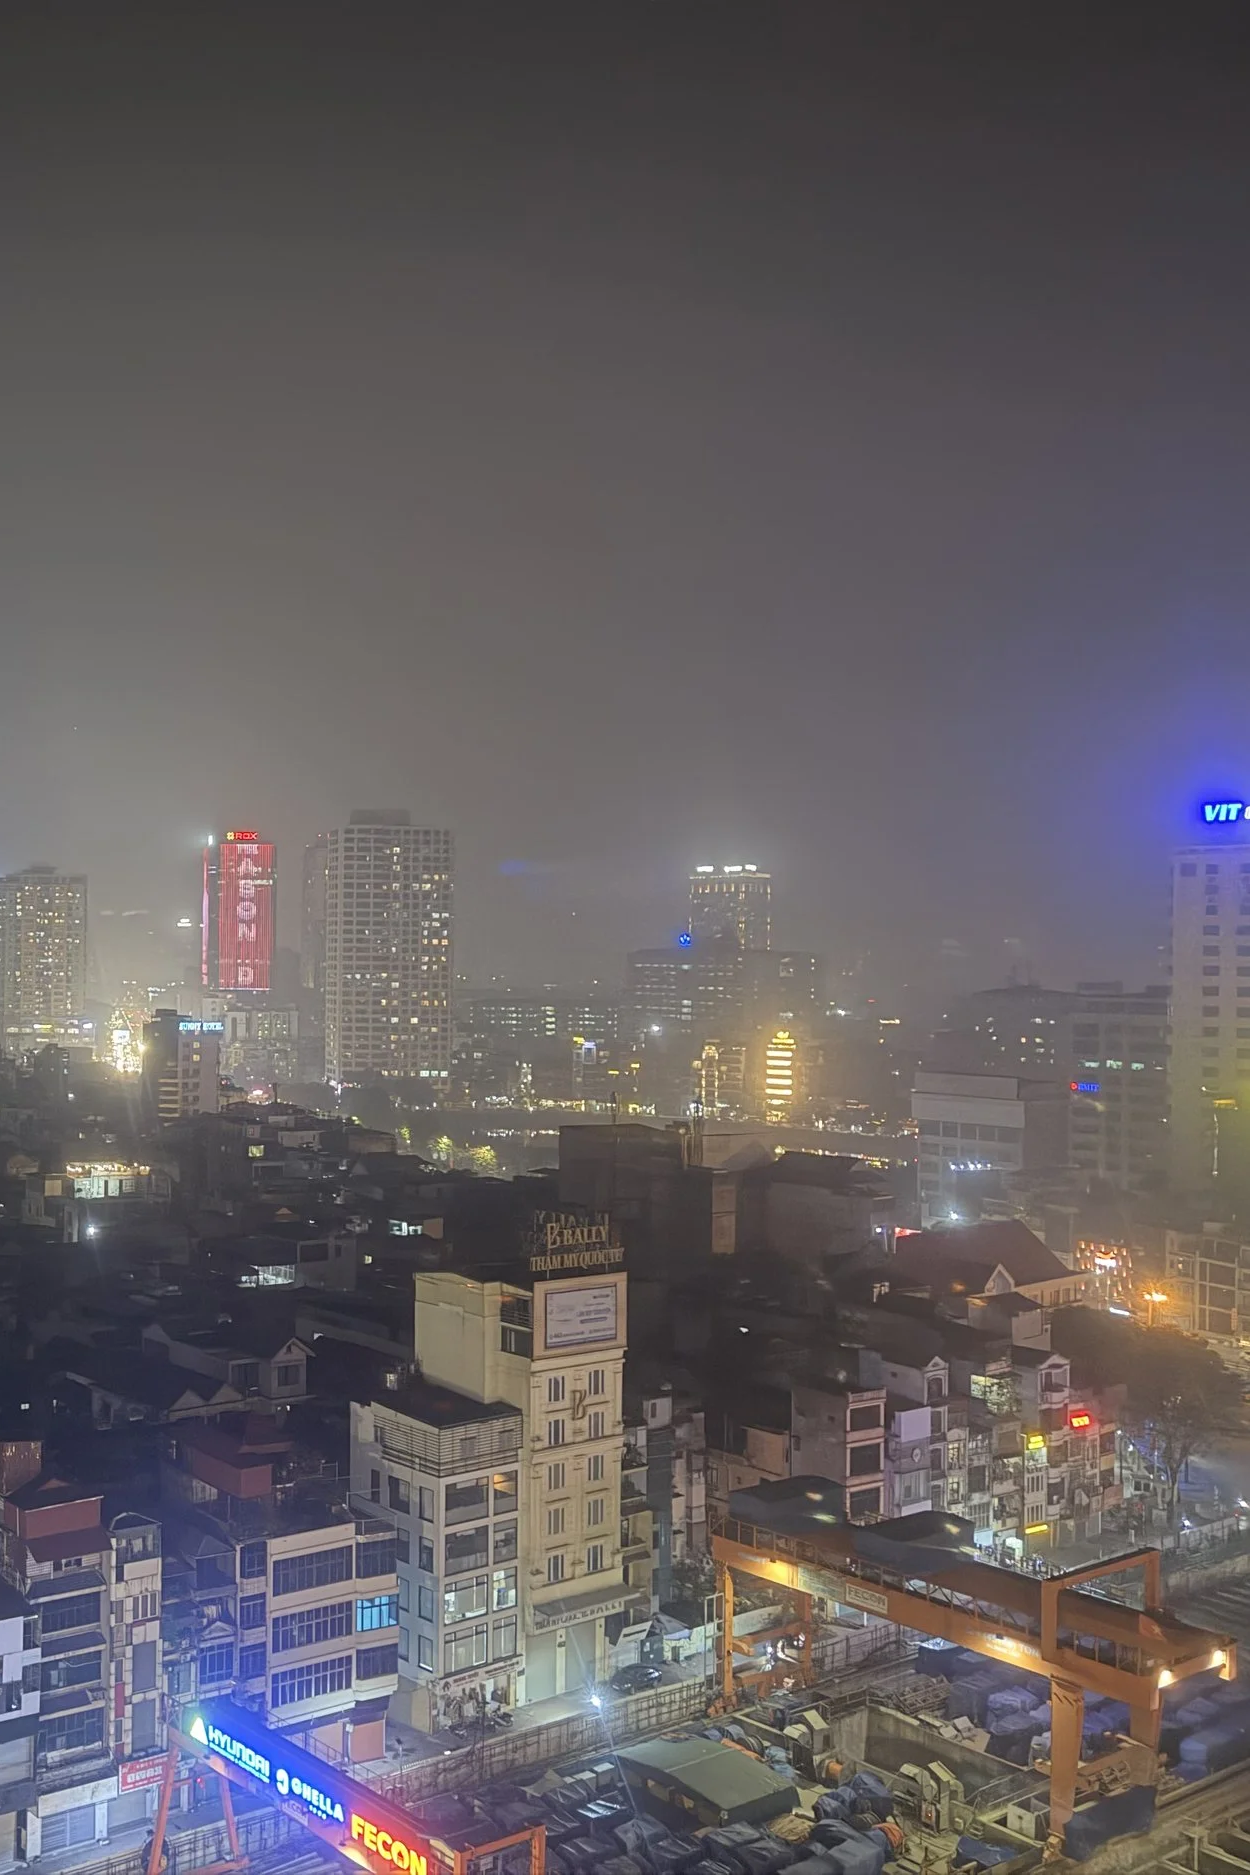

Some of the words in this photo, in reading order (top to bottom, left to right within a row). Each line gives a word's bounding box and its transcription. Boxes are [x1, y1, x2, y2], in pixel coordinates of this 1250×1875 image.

[1205, 803, 1242, 821] VIT
[235, 832, 258, 840] ROX
[563, 1226, 609, 1246] BALLY
[208, 1725, 270, 1777] HYUNDAI
[291, 1777, 344, 1822] GHELLA
[351, 1813, 427, 1875] FECON
